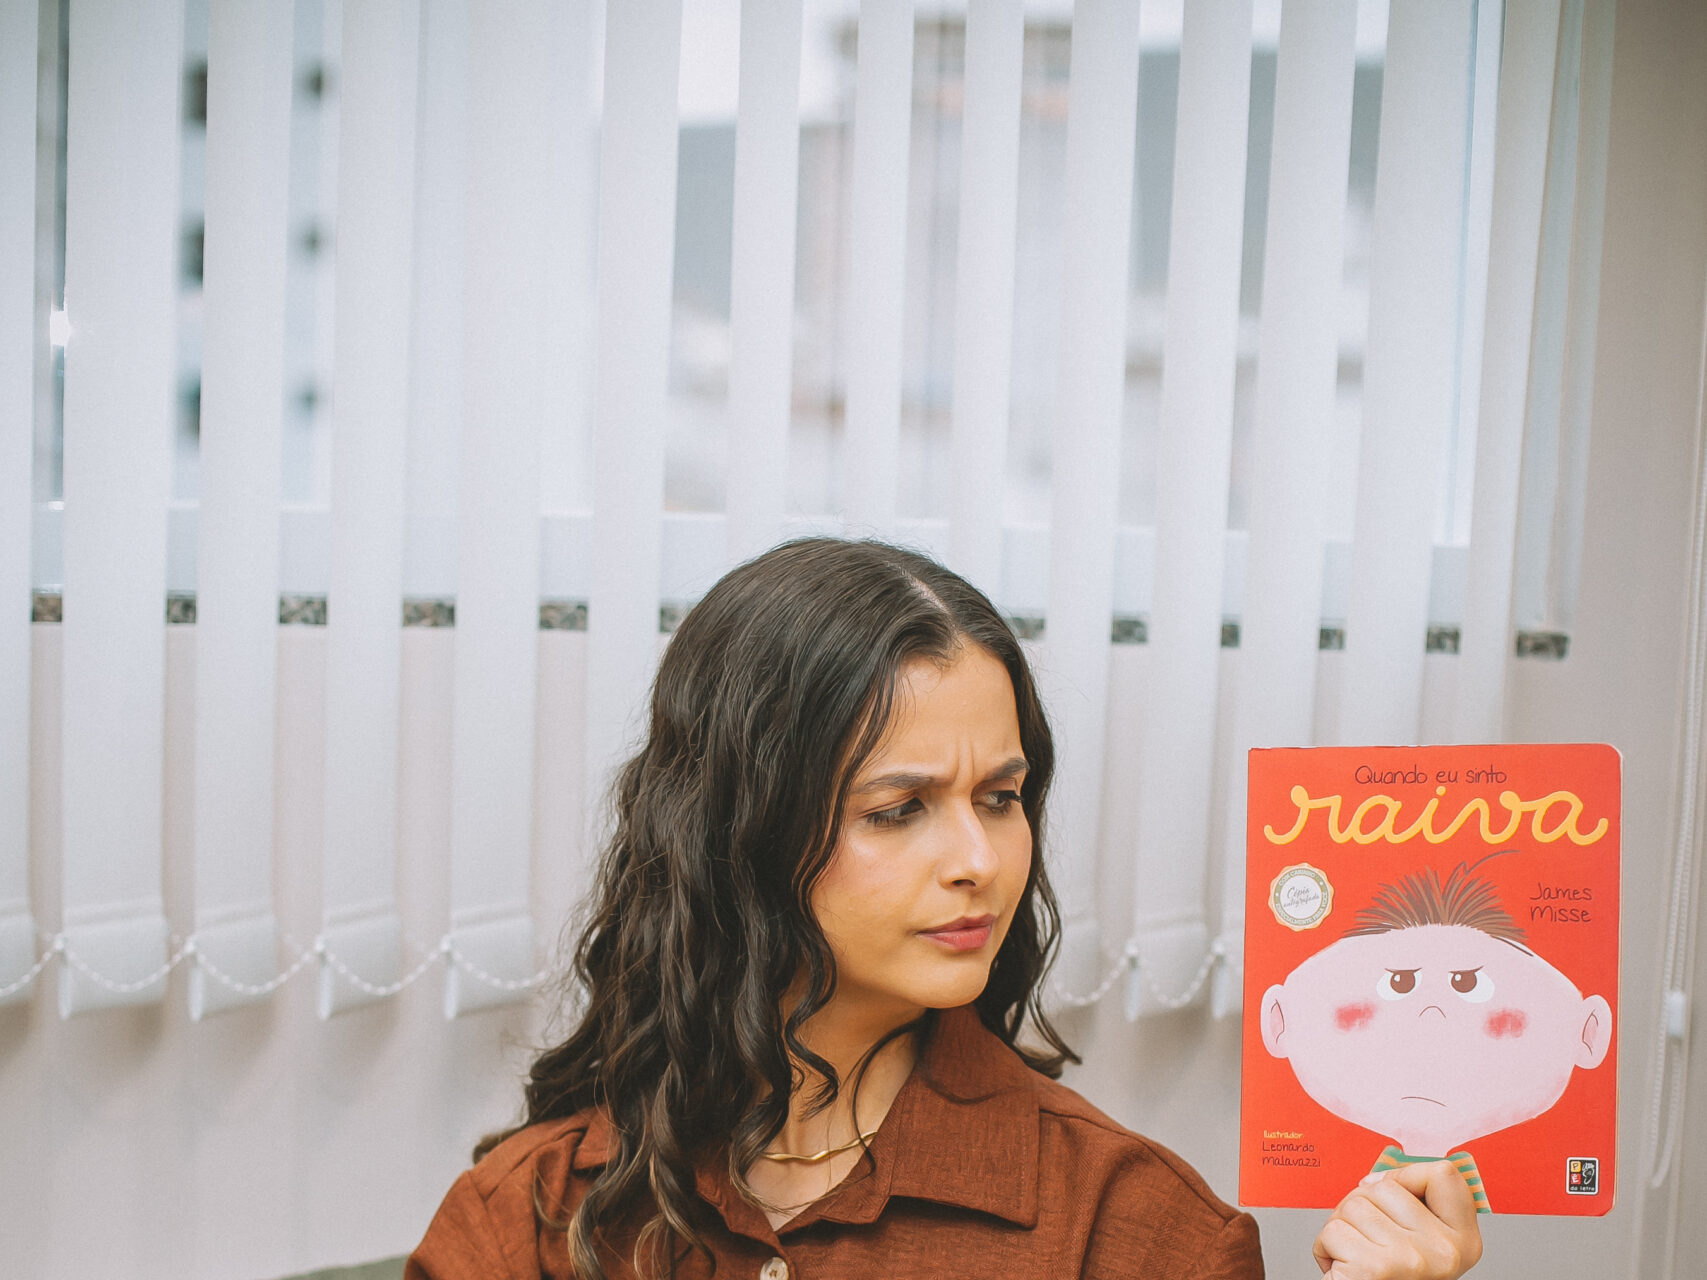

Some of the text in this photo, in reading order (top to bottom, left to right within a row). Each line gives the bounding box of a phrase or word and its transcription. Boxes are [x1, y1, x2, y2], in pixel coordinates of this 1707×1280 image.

[1354, 764, 1508, 785] Quando eu sinto
[1263, 785, 1609, 846] raiva
[1529, 882, 1592, 901] James
[1530, 905, 1592, 923] Misse
[1262, 1141, 1315, 1152] Leonardo
[1262, 1155, 1321, 1167] Malavazzi
